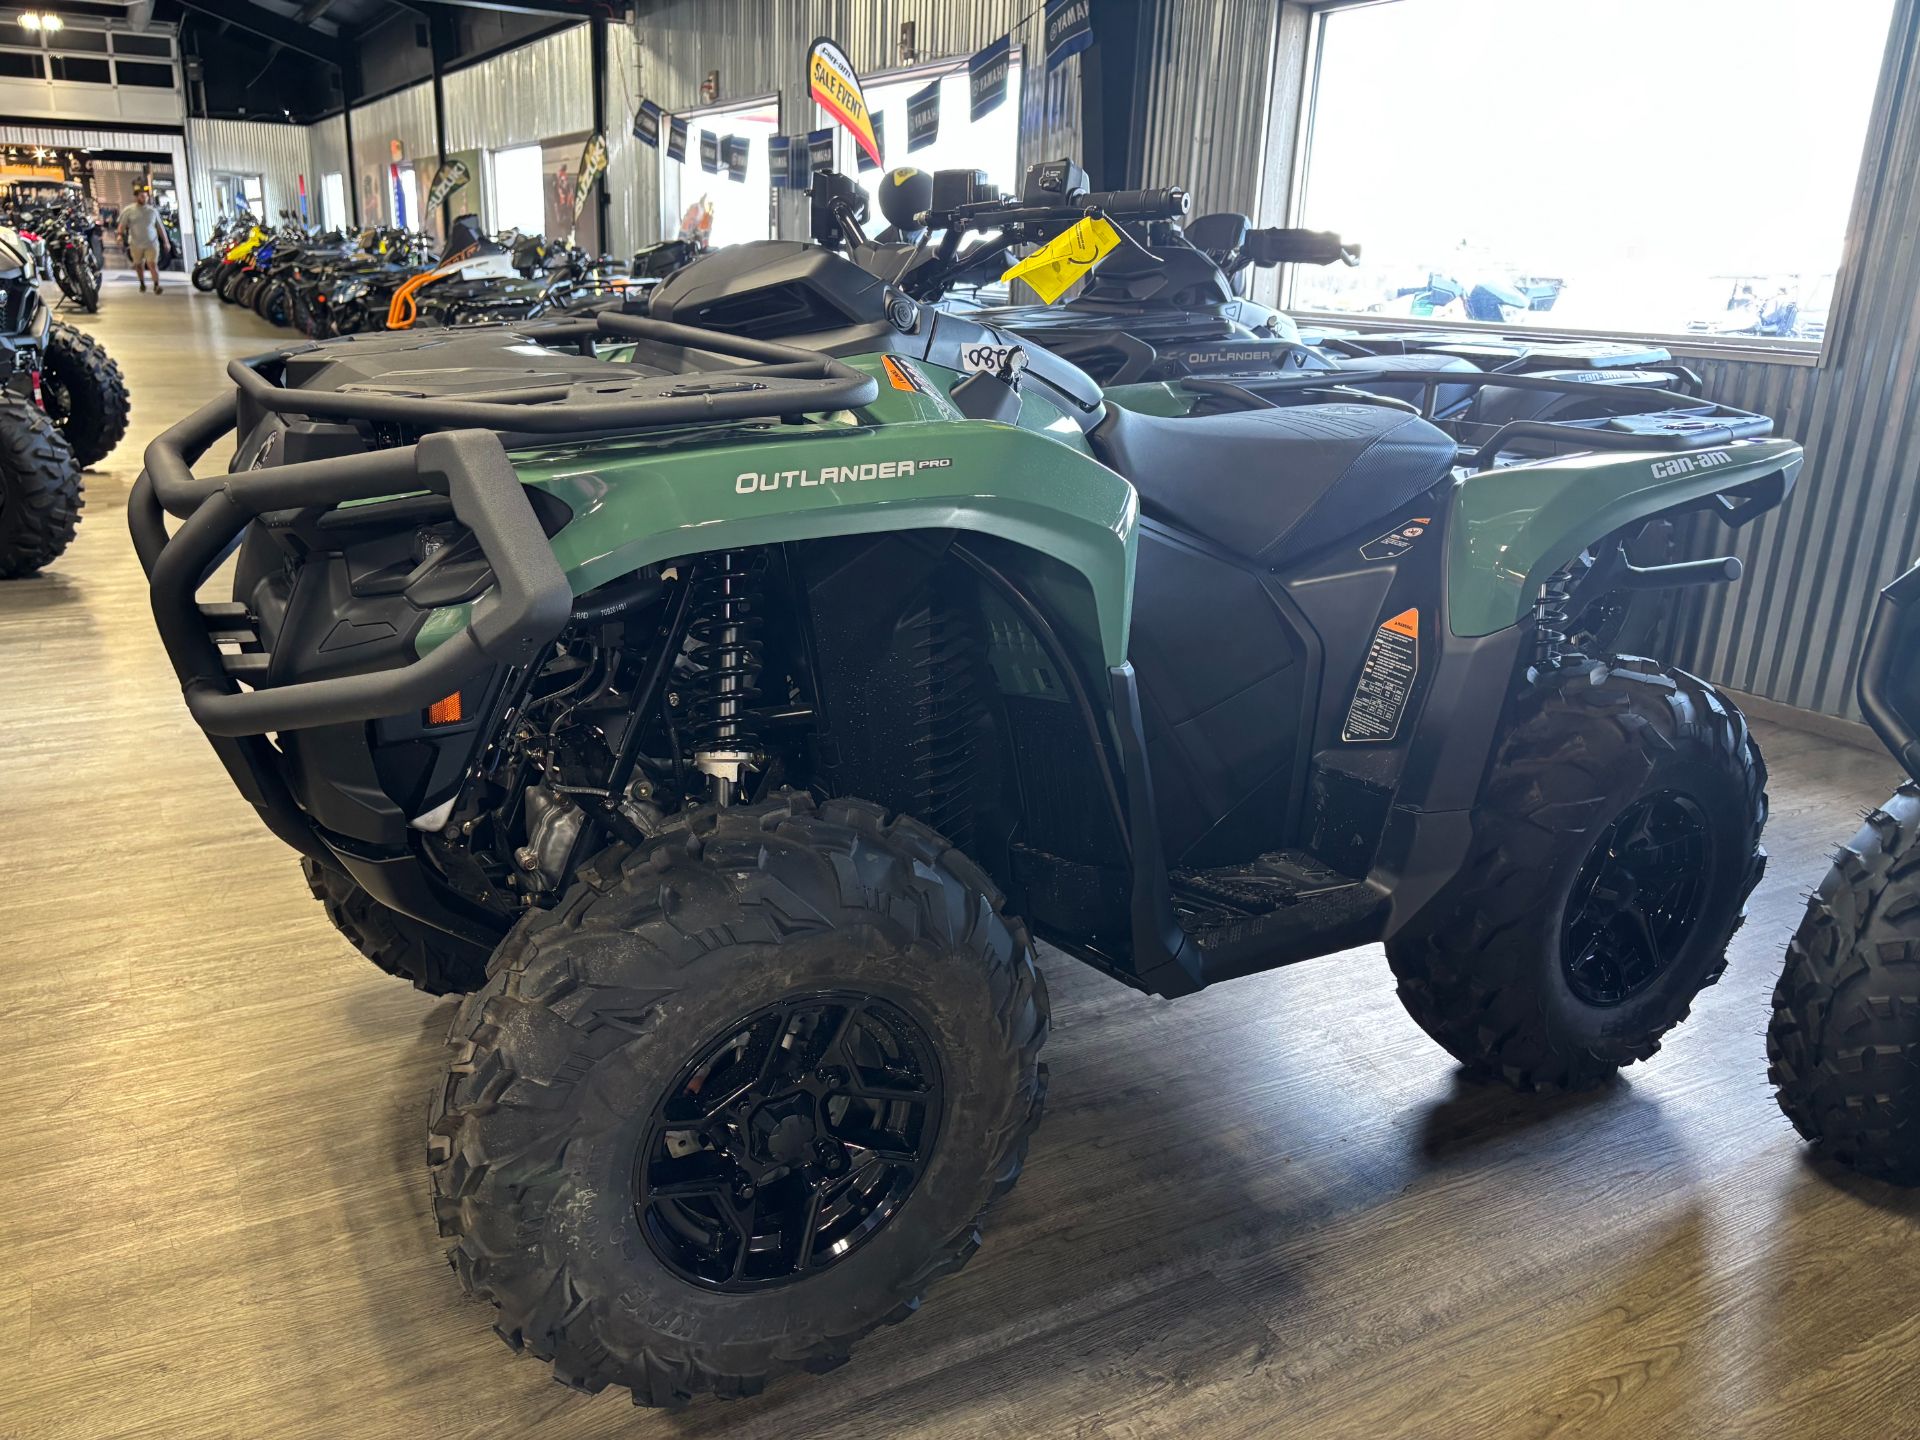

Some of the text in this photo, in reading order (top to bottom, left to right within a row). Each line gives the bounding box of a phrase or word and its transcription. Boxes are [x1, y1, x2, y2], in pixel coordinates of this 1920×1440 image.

[814, 62, 863, 119] SALE EVENT
[428, 162, 466, 216] SUZUKI
[575, 135, 606, 220] SUZUKI
[1188, 351, 1271, 364] OUTLANDER
[735, 459, 951, 494] OUTLANDER PRO
[1650, 450, 1732, 479] can-am
